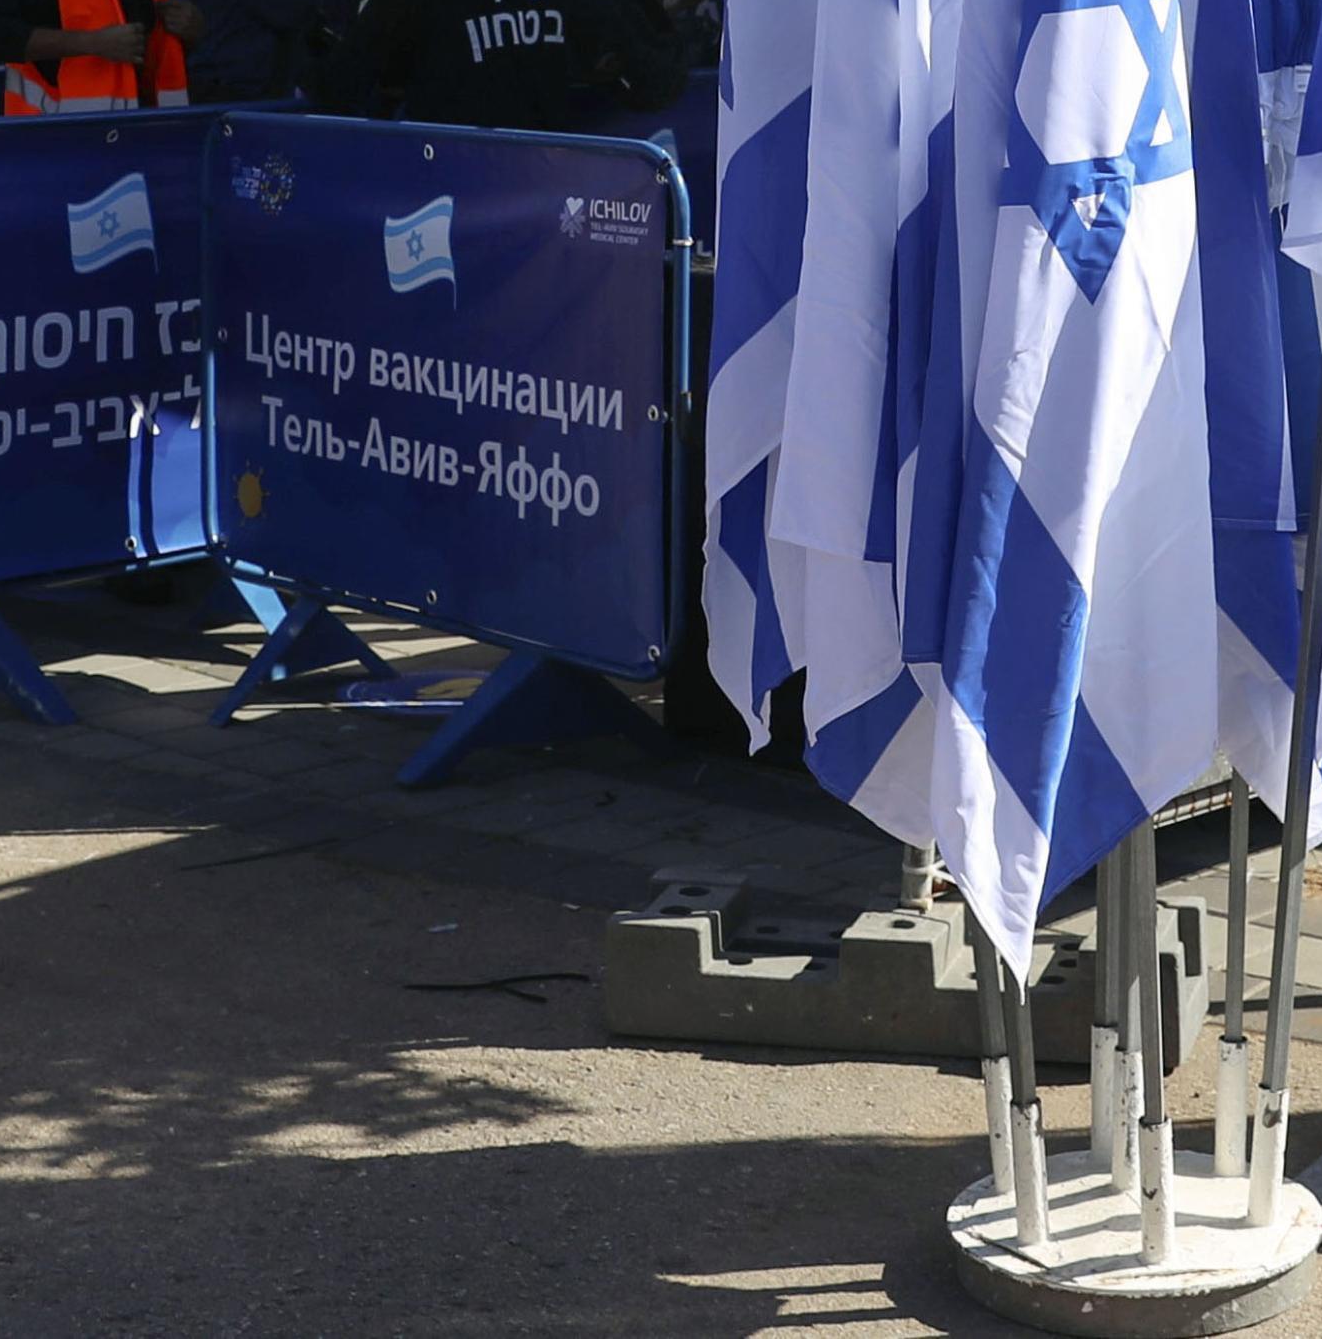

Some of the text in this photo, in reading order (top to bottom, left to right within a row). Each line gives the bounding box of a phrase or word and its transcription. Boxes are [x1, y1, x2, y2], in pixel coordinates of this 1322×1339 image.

[465, 10, 565, 63] בטחון
[589, 198, 652, 223] ICHILOV
[245, 311, 623, 435] Центр вакцинации
[261, 395, 601, 528] Тель-Авив-Яффо
